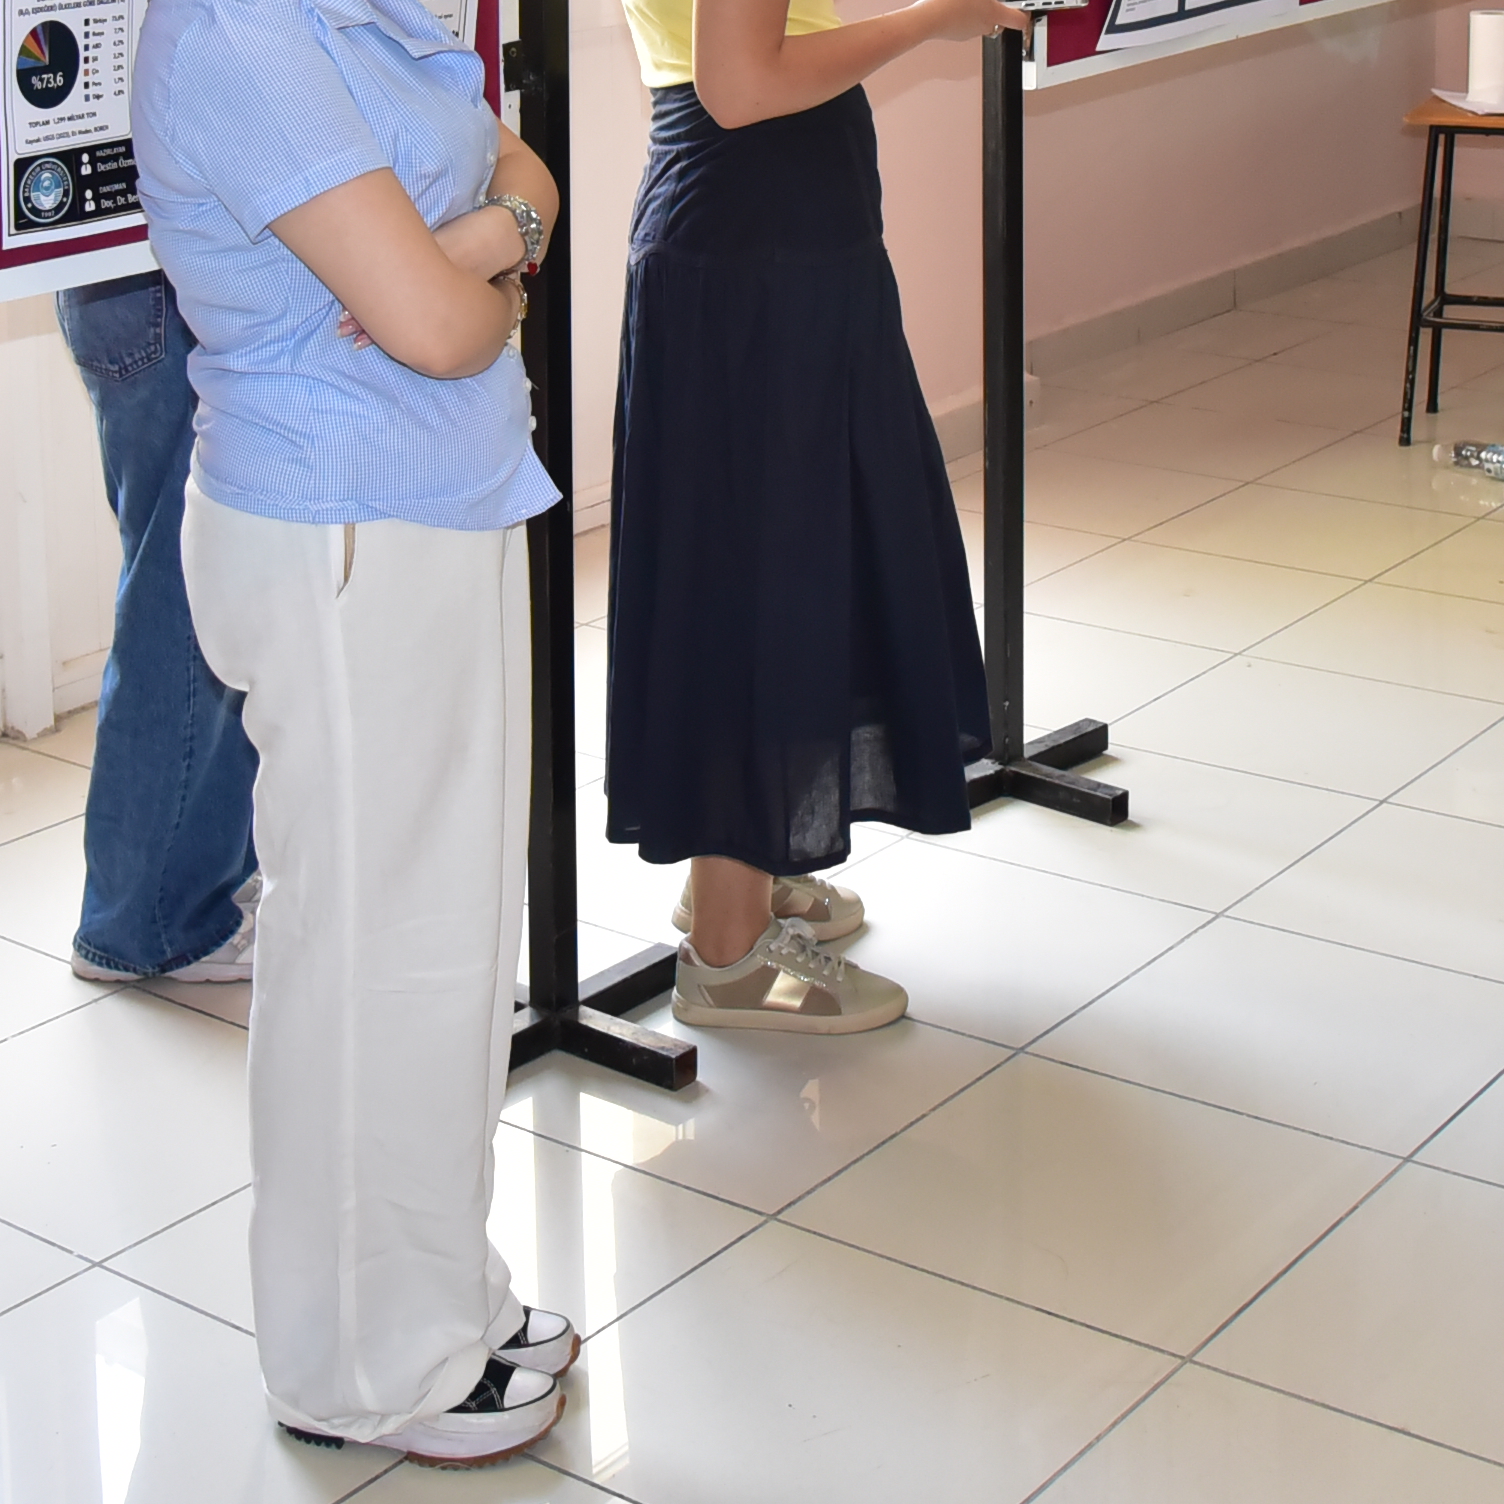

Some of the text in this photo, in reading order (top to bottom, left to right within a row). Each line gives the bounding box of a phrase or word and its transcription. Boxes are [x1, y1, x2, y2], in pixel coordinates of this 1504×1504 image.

[31, 72, 64, 90] %73,6
[100, 196, 127, 209] Doç. Dr.
